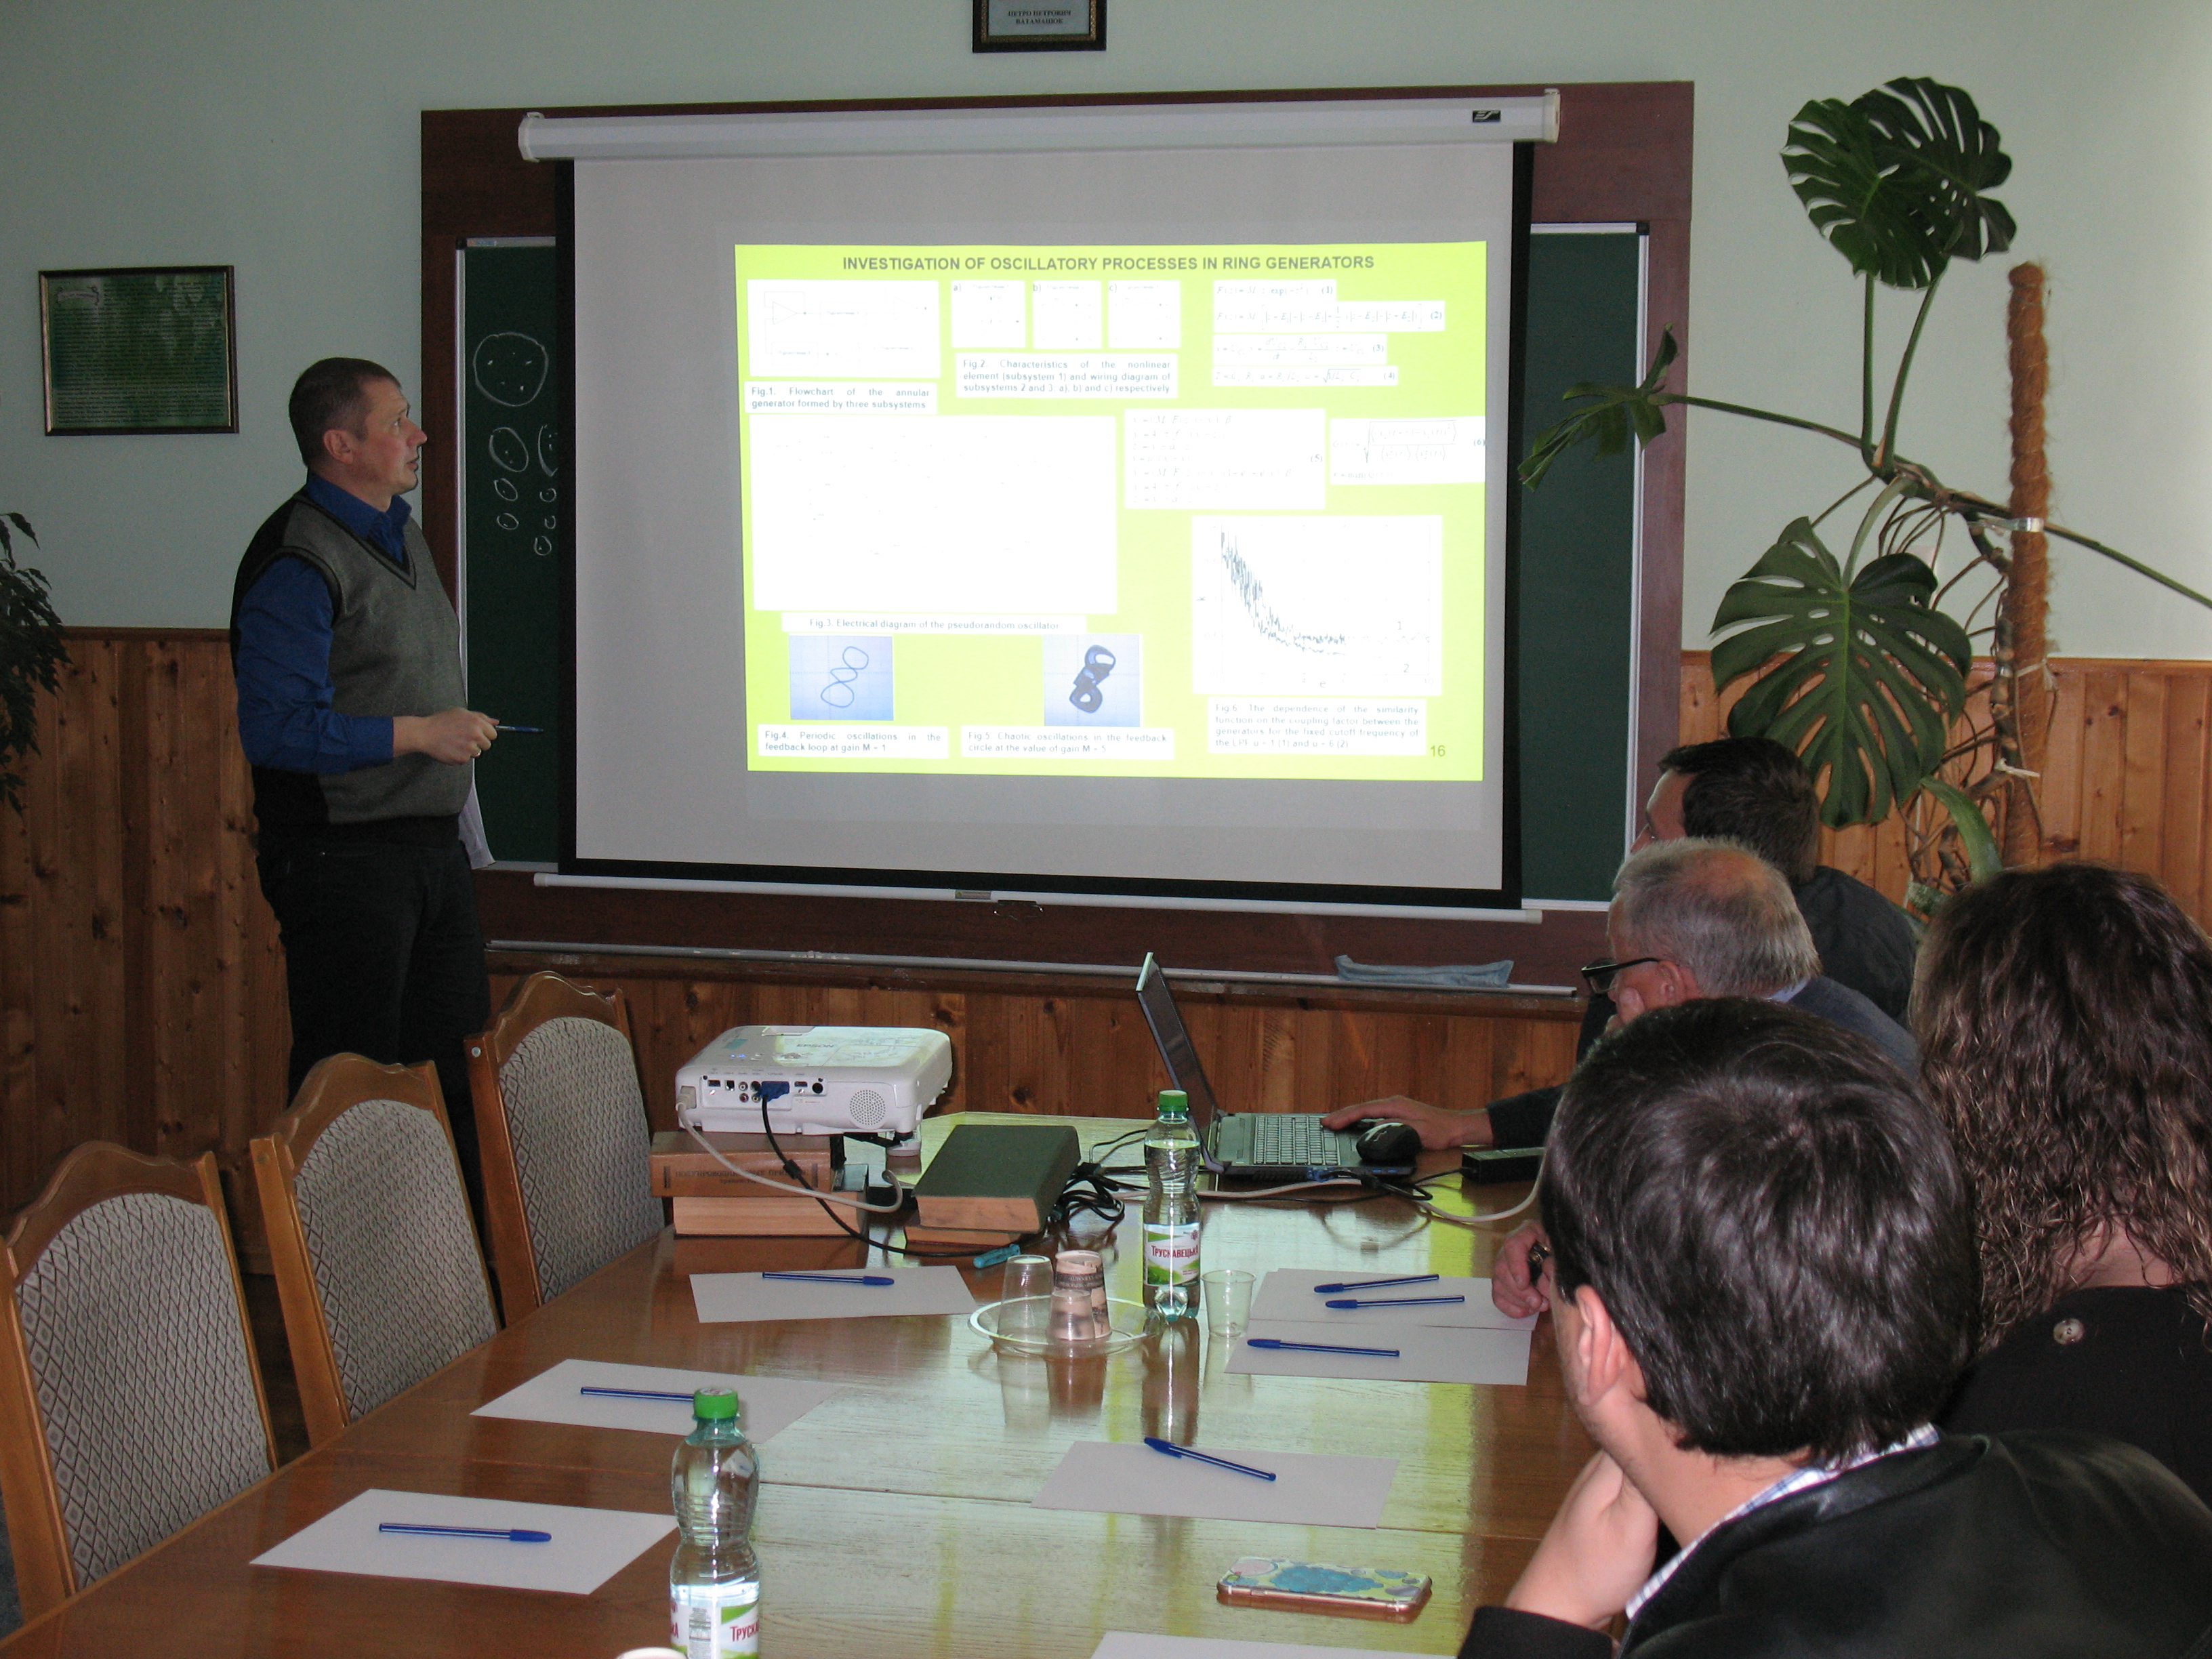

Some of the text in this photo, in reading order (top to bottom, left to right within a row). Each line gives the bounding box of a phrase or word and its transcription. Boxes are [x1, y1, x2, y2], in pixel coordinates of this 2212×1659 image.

[843, 255, 1374, 270] INVESTIGATION OF OSCILLATORY PROCESSES IN RING GENERATORS
[1000, 359, 1068, 369] Characteristics
[1080, 360, 1089, 369] of
[1101, 360, 1115, 369] the
[1128, 360, 1170, 369] nonlinear
[963, 371, 999, 380] element
[1069, 372, 1086, 381] and
[1090, 372, 1118, 382] wiring
[1121, 372, 1158, 382] diagram
[1162, 372, 1170, 381] of
[789, 386, 834, 396] Flowchart
[846, 388, 856, 396] of
[868, 388, 883, 396] the
[895, 388, 929, 397] annular
[964, 383, 1018, 393] subsystems
[1021, 383, 1026, 392] 2
[1028, 384, 1046, 392] and
[1084, 384, 1101, 392] and
[1115, 384, 1170, 394] respectively
[752, 398, 926, 410] generator formed by three subsystems
[836, 618, 878, 628] Electrical
[880, 619, 916, 629] diagram
[919, 620, 928, 628] of
[930, 620, 945, 628] the
[1273, 704, 1329, 714] dependence
[1336, 705, 1346, 713] of
[1362, 718, 1401, 726] between
[1404, 717, 1419, 726] the
[800, 731, 836, 740] Periodic
[846, 732, 898, 741] oscillations
[908, 733, 916, 741] in
[926, 733, 941, 741] the
[1285, 727, 1300, 735] the
[998, 732, 1031, 741] Chaotic
[1037, 733, 1088, 741] oscillations
[1126, 733, 1166, 742] feedback
[765, 742, 806, 752] feedback
[808, 743, 828, 754] loop
[841, 743, 860, 754] gain
[862, 743, 870, 752] M
[1215, 739, 1229, 747] the
[1292, 739, 1309, 747] and
[968, 743, 993, 752] circle
[1006, 743, 1020, 752] the
[1023, 744, 1046, 752] value
[1048, 744, 1058, 752] of
[1061, 745, 1080, 755] gain
[1082, 744, 1090, 752] M
[1430, 745, 1446, 757] 16
